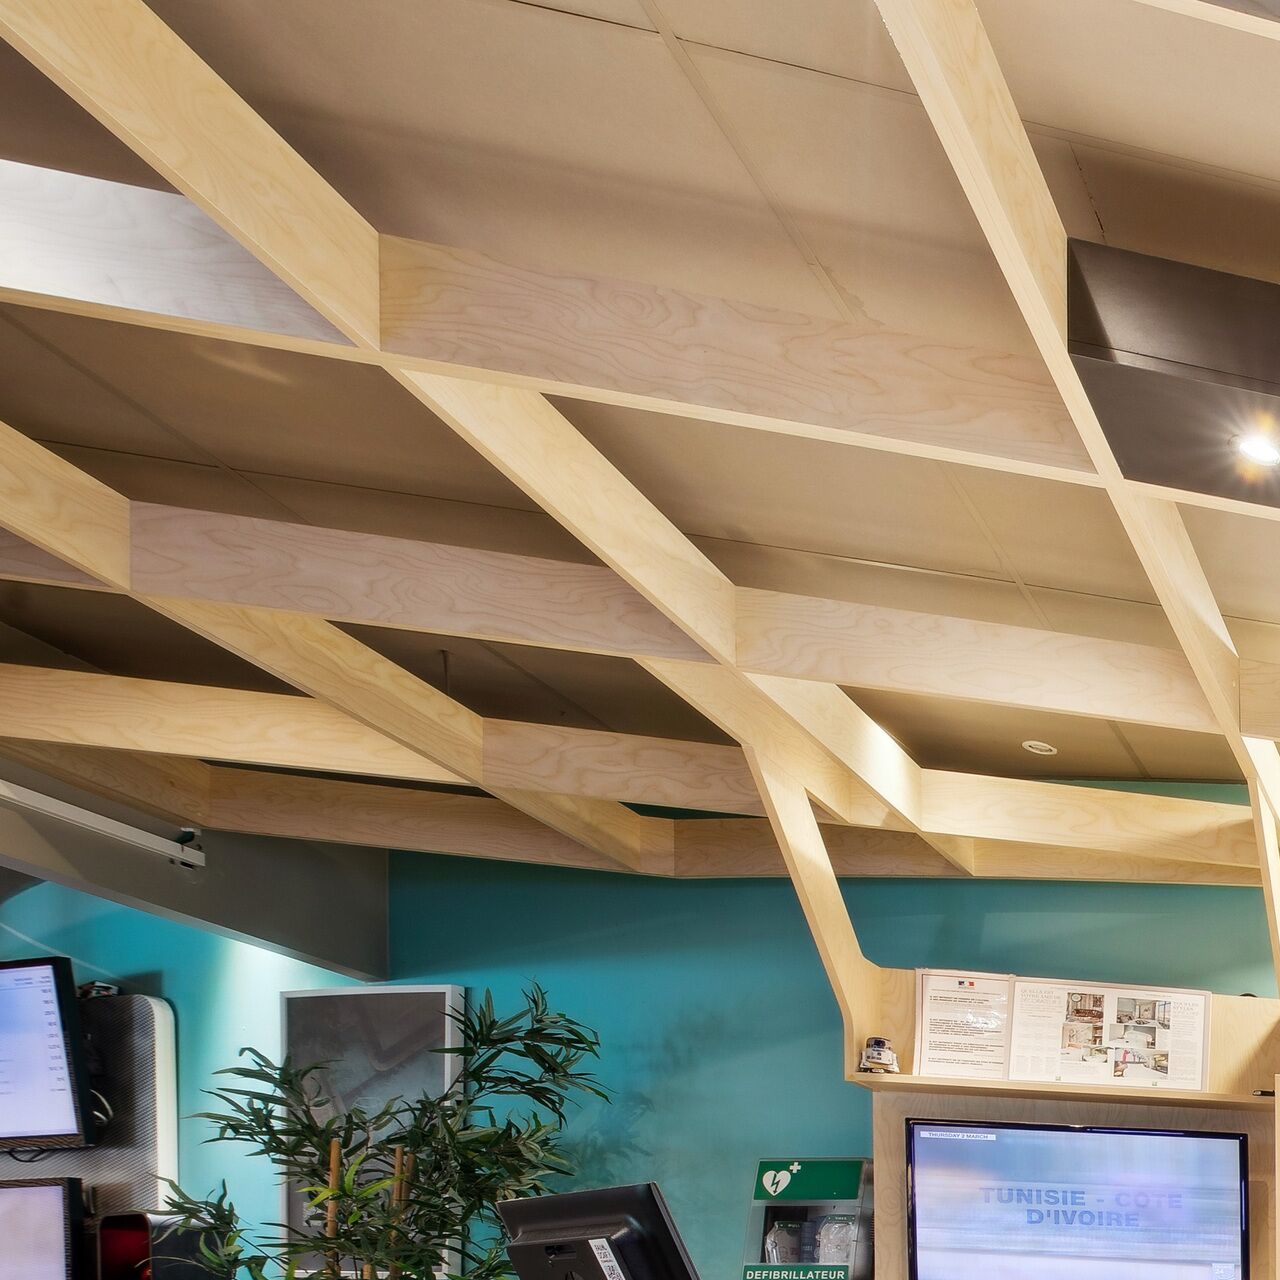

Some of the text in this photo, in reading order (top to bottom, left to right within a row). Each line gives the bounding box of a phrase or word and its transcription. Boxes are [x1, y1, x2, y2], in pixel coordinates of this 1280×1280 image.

[980, 1187, 1086, 1206] TUNISIE
[1026, 1208, 1140, 1227] D'IVOIRE
[746, 1271, 845, 1280] DEFIBRILLATEUR
